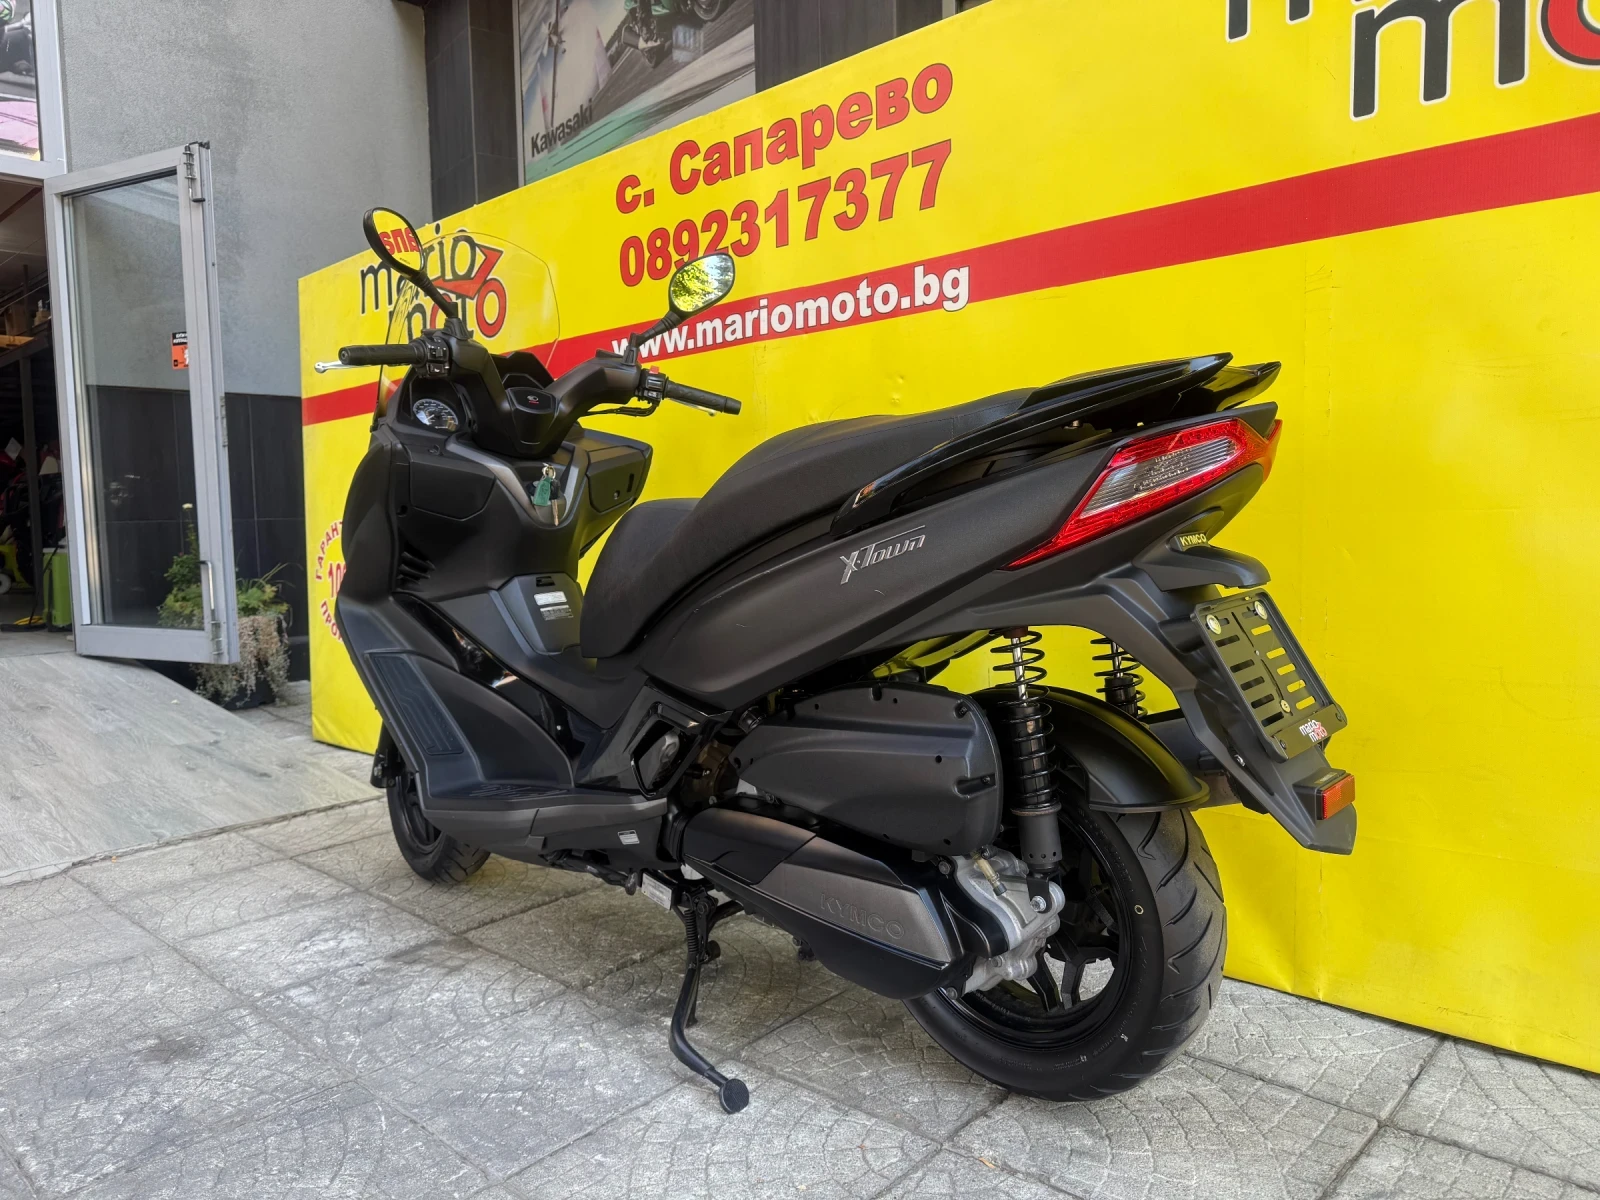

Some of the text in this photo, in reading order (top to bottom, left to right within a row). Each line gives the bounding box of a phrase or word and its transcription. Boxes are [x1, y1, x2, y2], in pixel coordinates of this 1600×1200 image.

[531, 97, 592, 158] Kawasaki
[615, 62, 953, 214] с. Сапарево
[620, 138, 951, 287] 0892317377
[315, 520, 343, 580] ГАРАН
[1180, 533, 1207, 547] KYMCO
[820, 893, 905, 939] KYMCO
